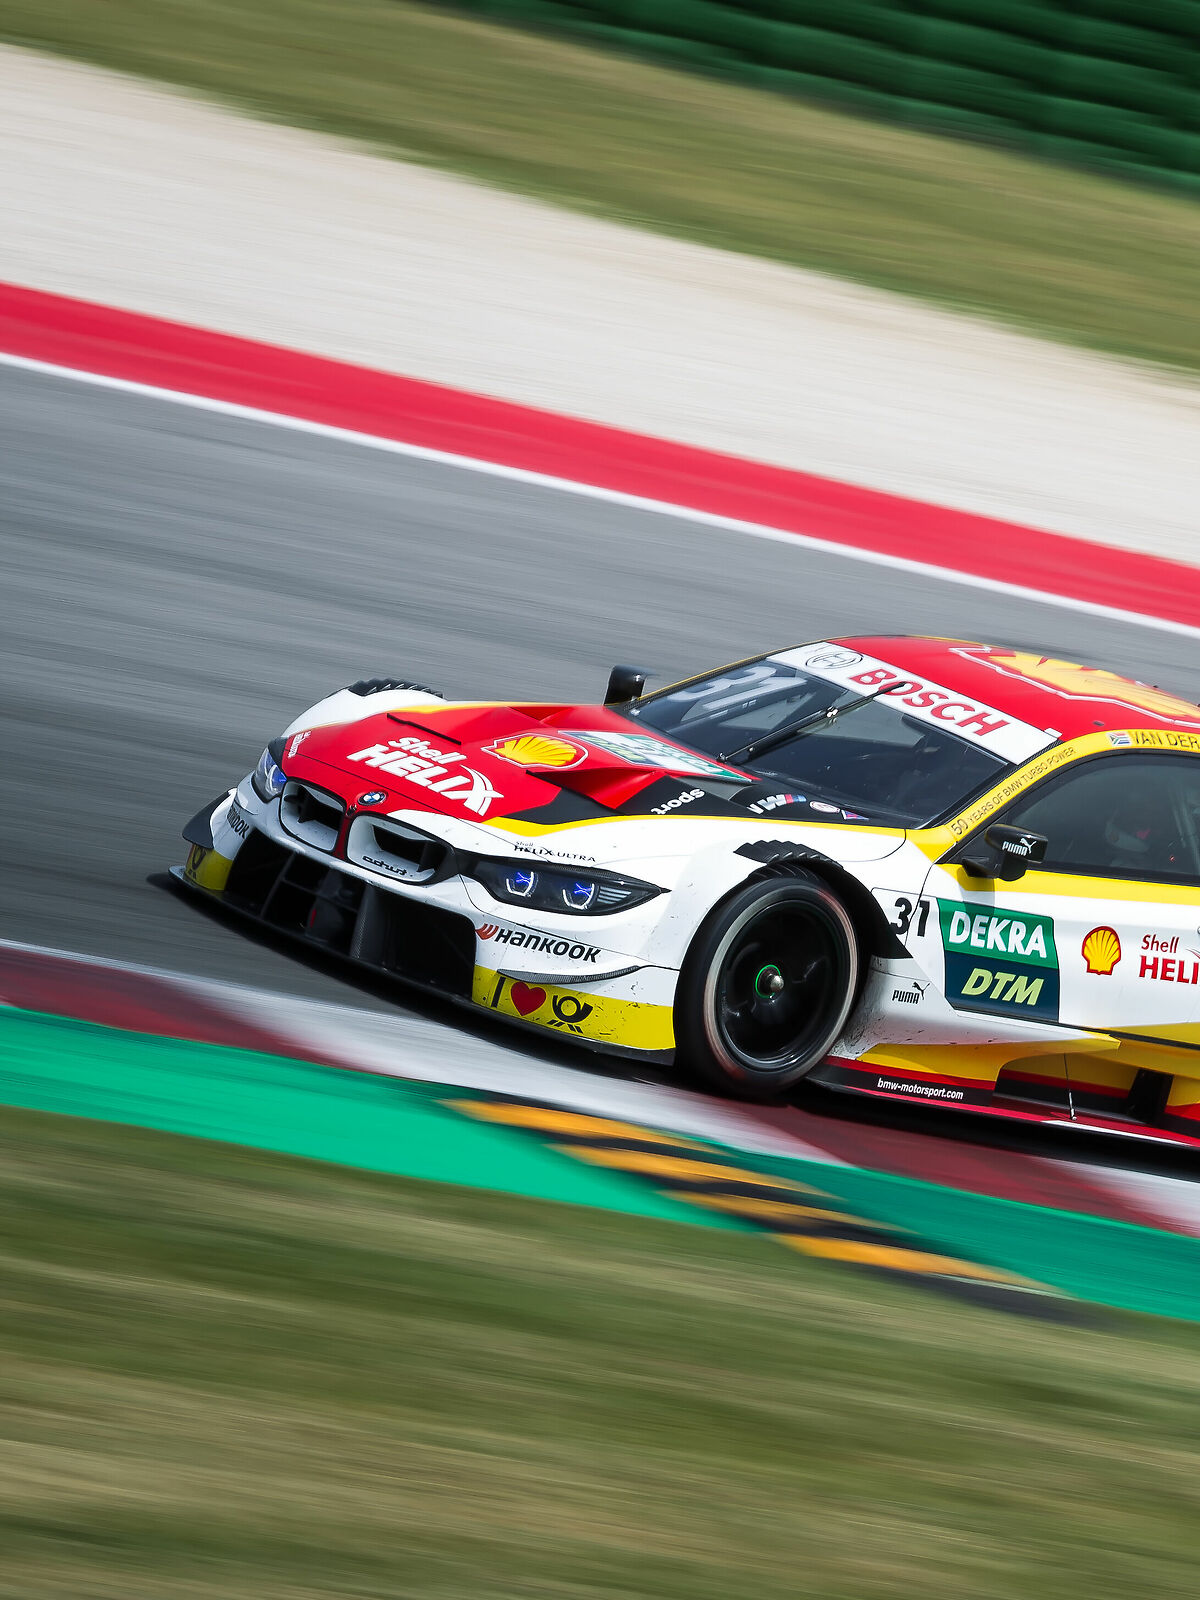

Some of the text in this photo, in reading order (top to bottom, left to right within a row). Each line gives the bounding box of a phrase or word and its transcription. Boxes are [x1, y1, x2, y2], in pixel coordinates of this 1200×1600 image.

[846, 668, 1012, 737] BOSCH
[388, 736, 467, 765] Shell
[1131, 731, 1163, 745] VAN
[1166, 733, 1200, 750] DER
[346, 743, 504, 816] HELIX
[951, 747, 1076, 836] 50 YEARS OF BMW TURBO POWER
[1002, 841, 1028, 857] PUMA
[890, 897, 930, 937] 31
[949, 910, 1048, 959] DEKRA
[1141, 934, 1180, 954] Shell
[892, 989, 920, 1005] PUMA
[961, 967, 1045, 1006] DTM
[877, 1078, 964, 1100] bmw-motorsport.com
